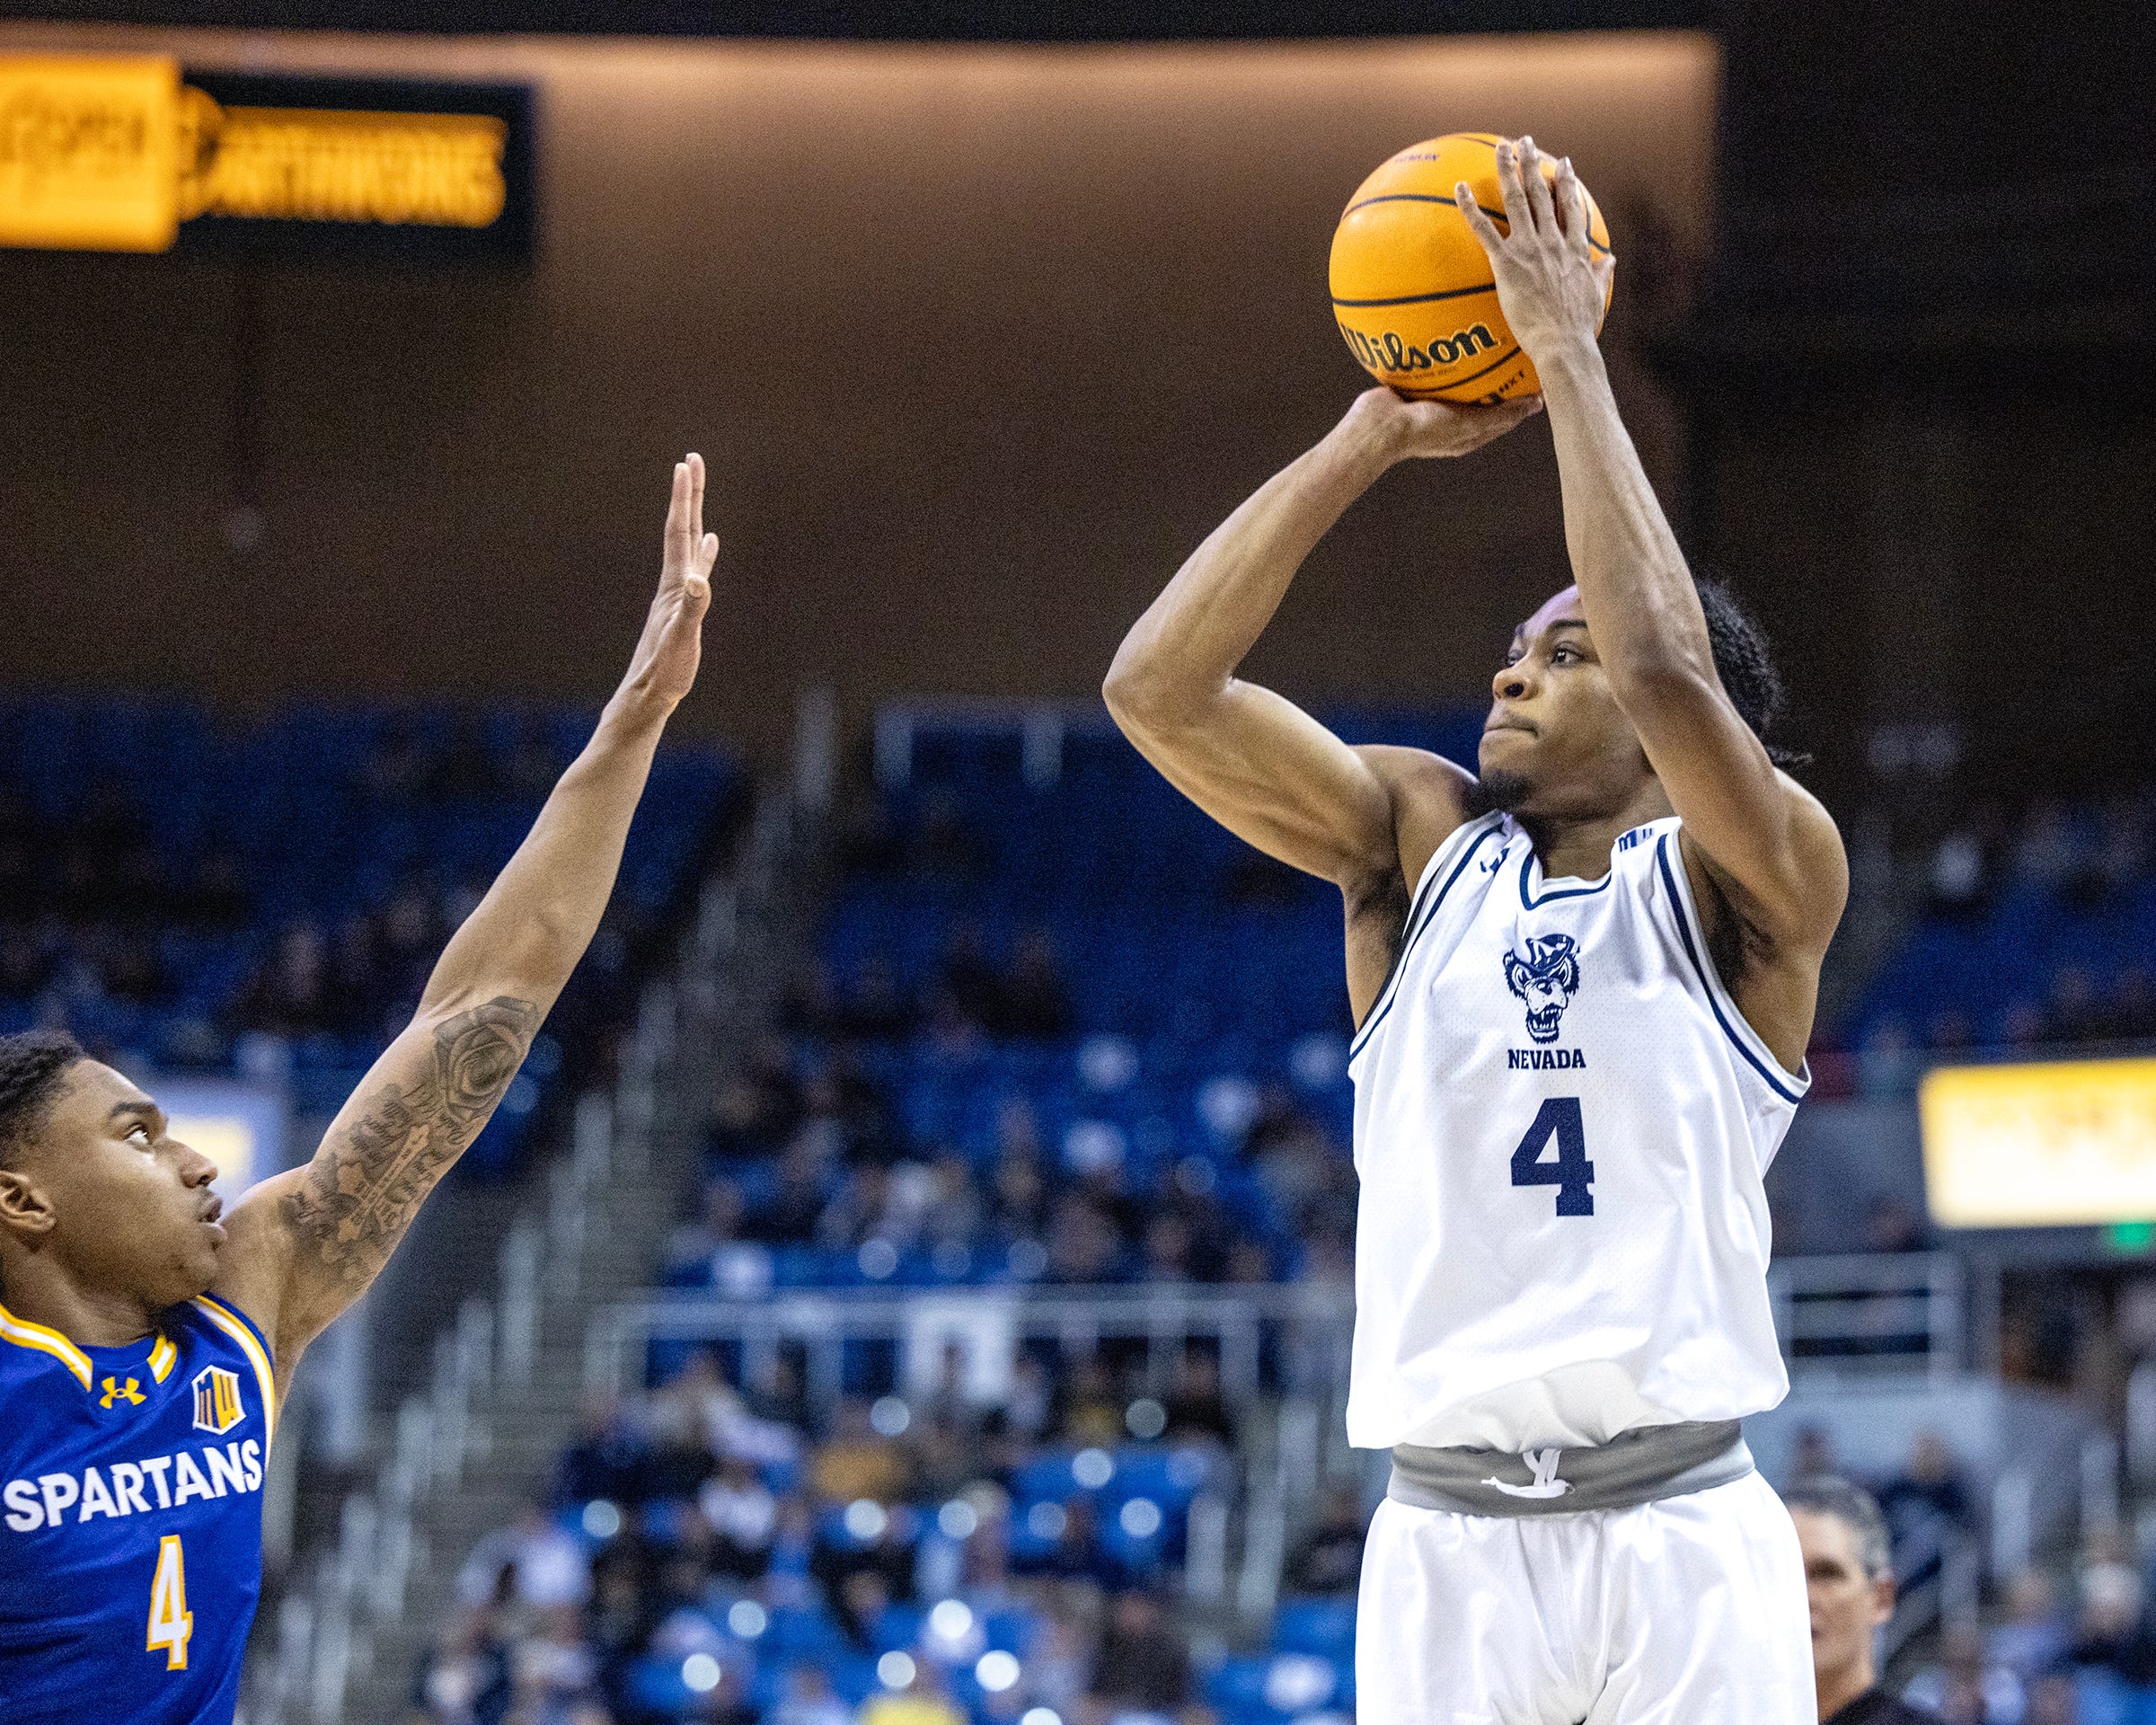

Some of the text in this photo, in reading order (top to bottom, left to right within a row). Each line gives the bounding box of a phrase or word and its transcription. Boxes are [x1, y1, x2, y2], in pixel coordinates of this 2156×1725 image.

[1339, 322, 1500, 371] Wilson
[1507, 1048, 1586, 1070] NEVADA
[1510, 1096, 1595, 1217] 4
[4, 1438, 263, 1533] SPARTANS
[146, 1534, 194, 1671] 4
